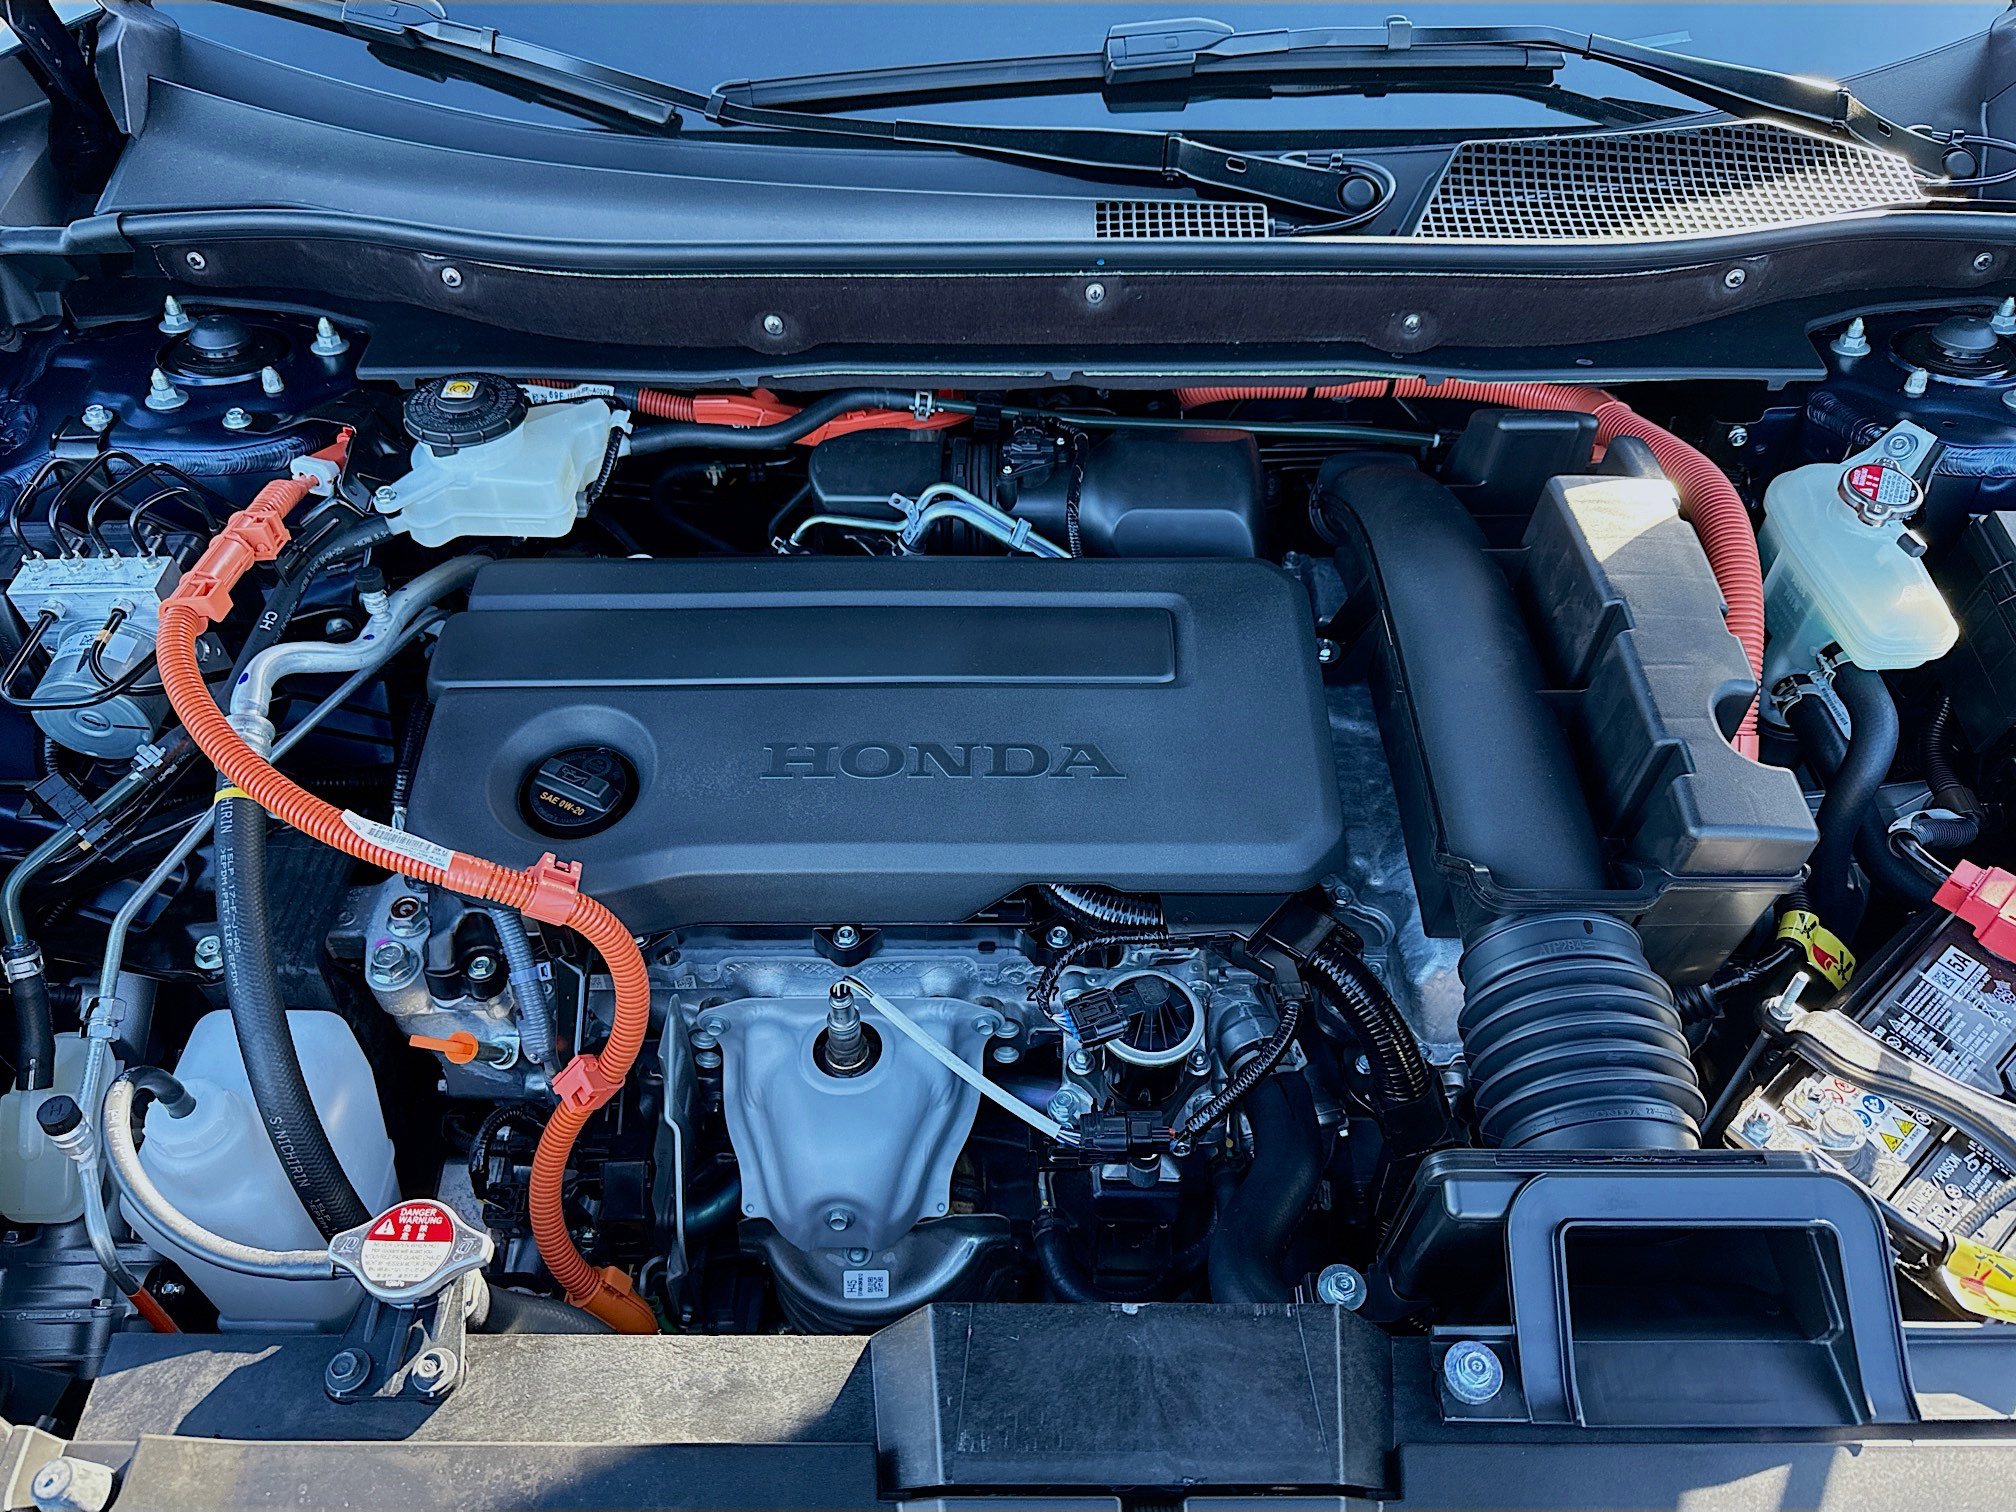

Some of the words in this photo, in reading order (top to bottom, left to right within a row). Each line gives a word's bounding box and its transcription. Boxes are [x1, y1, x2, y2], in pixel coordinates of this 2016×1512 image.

[759, 742, 1127, 780] HONDA
[540, 791, 561, 805] SAE
[558, 799, 585, 816] 0W-20
[1947, 953, 1972, 973] 5A
[398, 1216, 443, 1225] WARNUNG
[400, 1208, 438, 1217] DANGER
